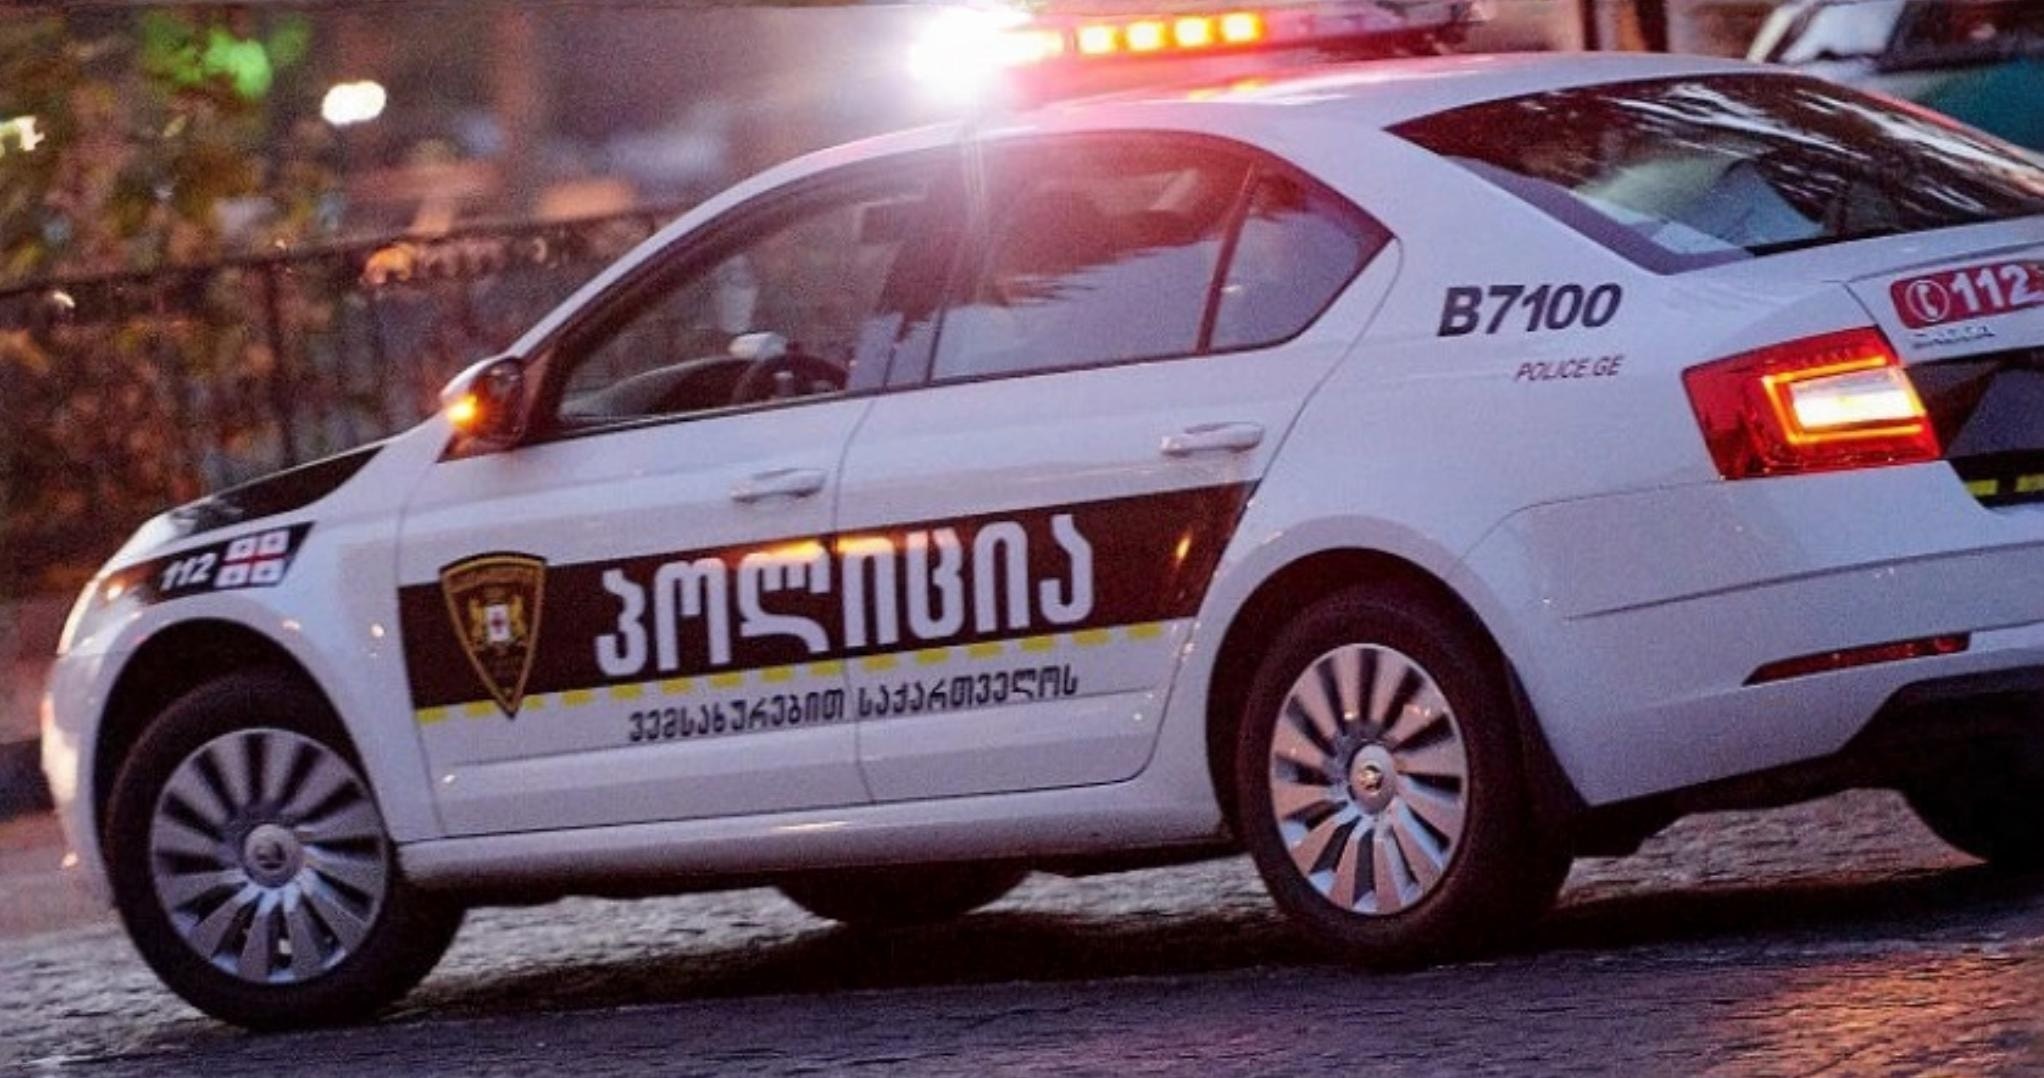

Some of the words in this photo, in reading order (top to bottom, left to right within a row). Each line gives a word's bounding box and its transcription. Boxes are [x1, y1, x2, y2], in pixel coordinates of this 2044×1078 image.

[1437, 283, 1622, 336] B7100
[1952, 264, 2043, 311] 112
[160, 553, 217, 590] 112
[595, 514, 1094, 676] პოლიცია
[629, 689, 844, 742] ვემსახურებით
[858, 664, 1078, 716] საქართველოს
